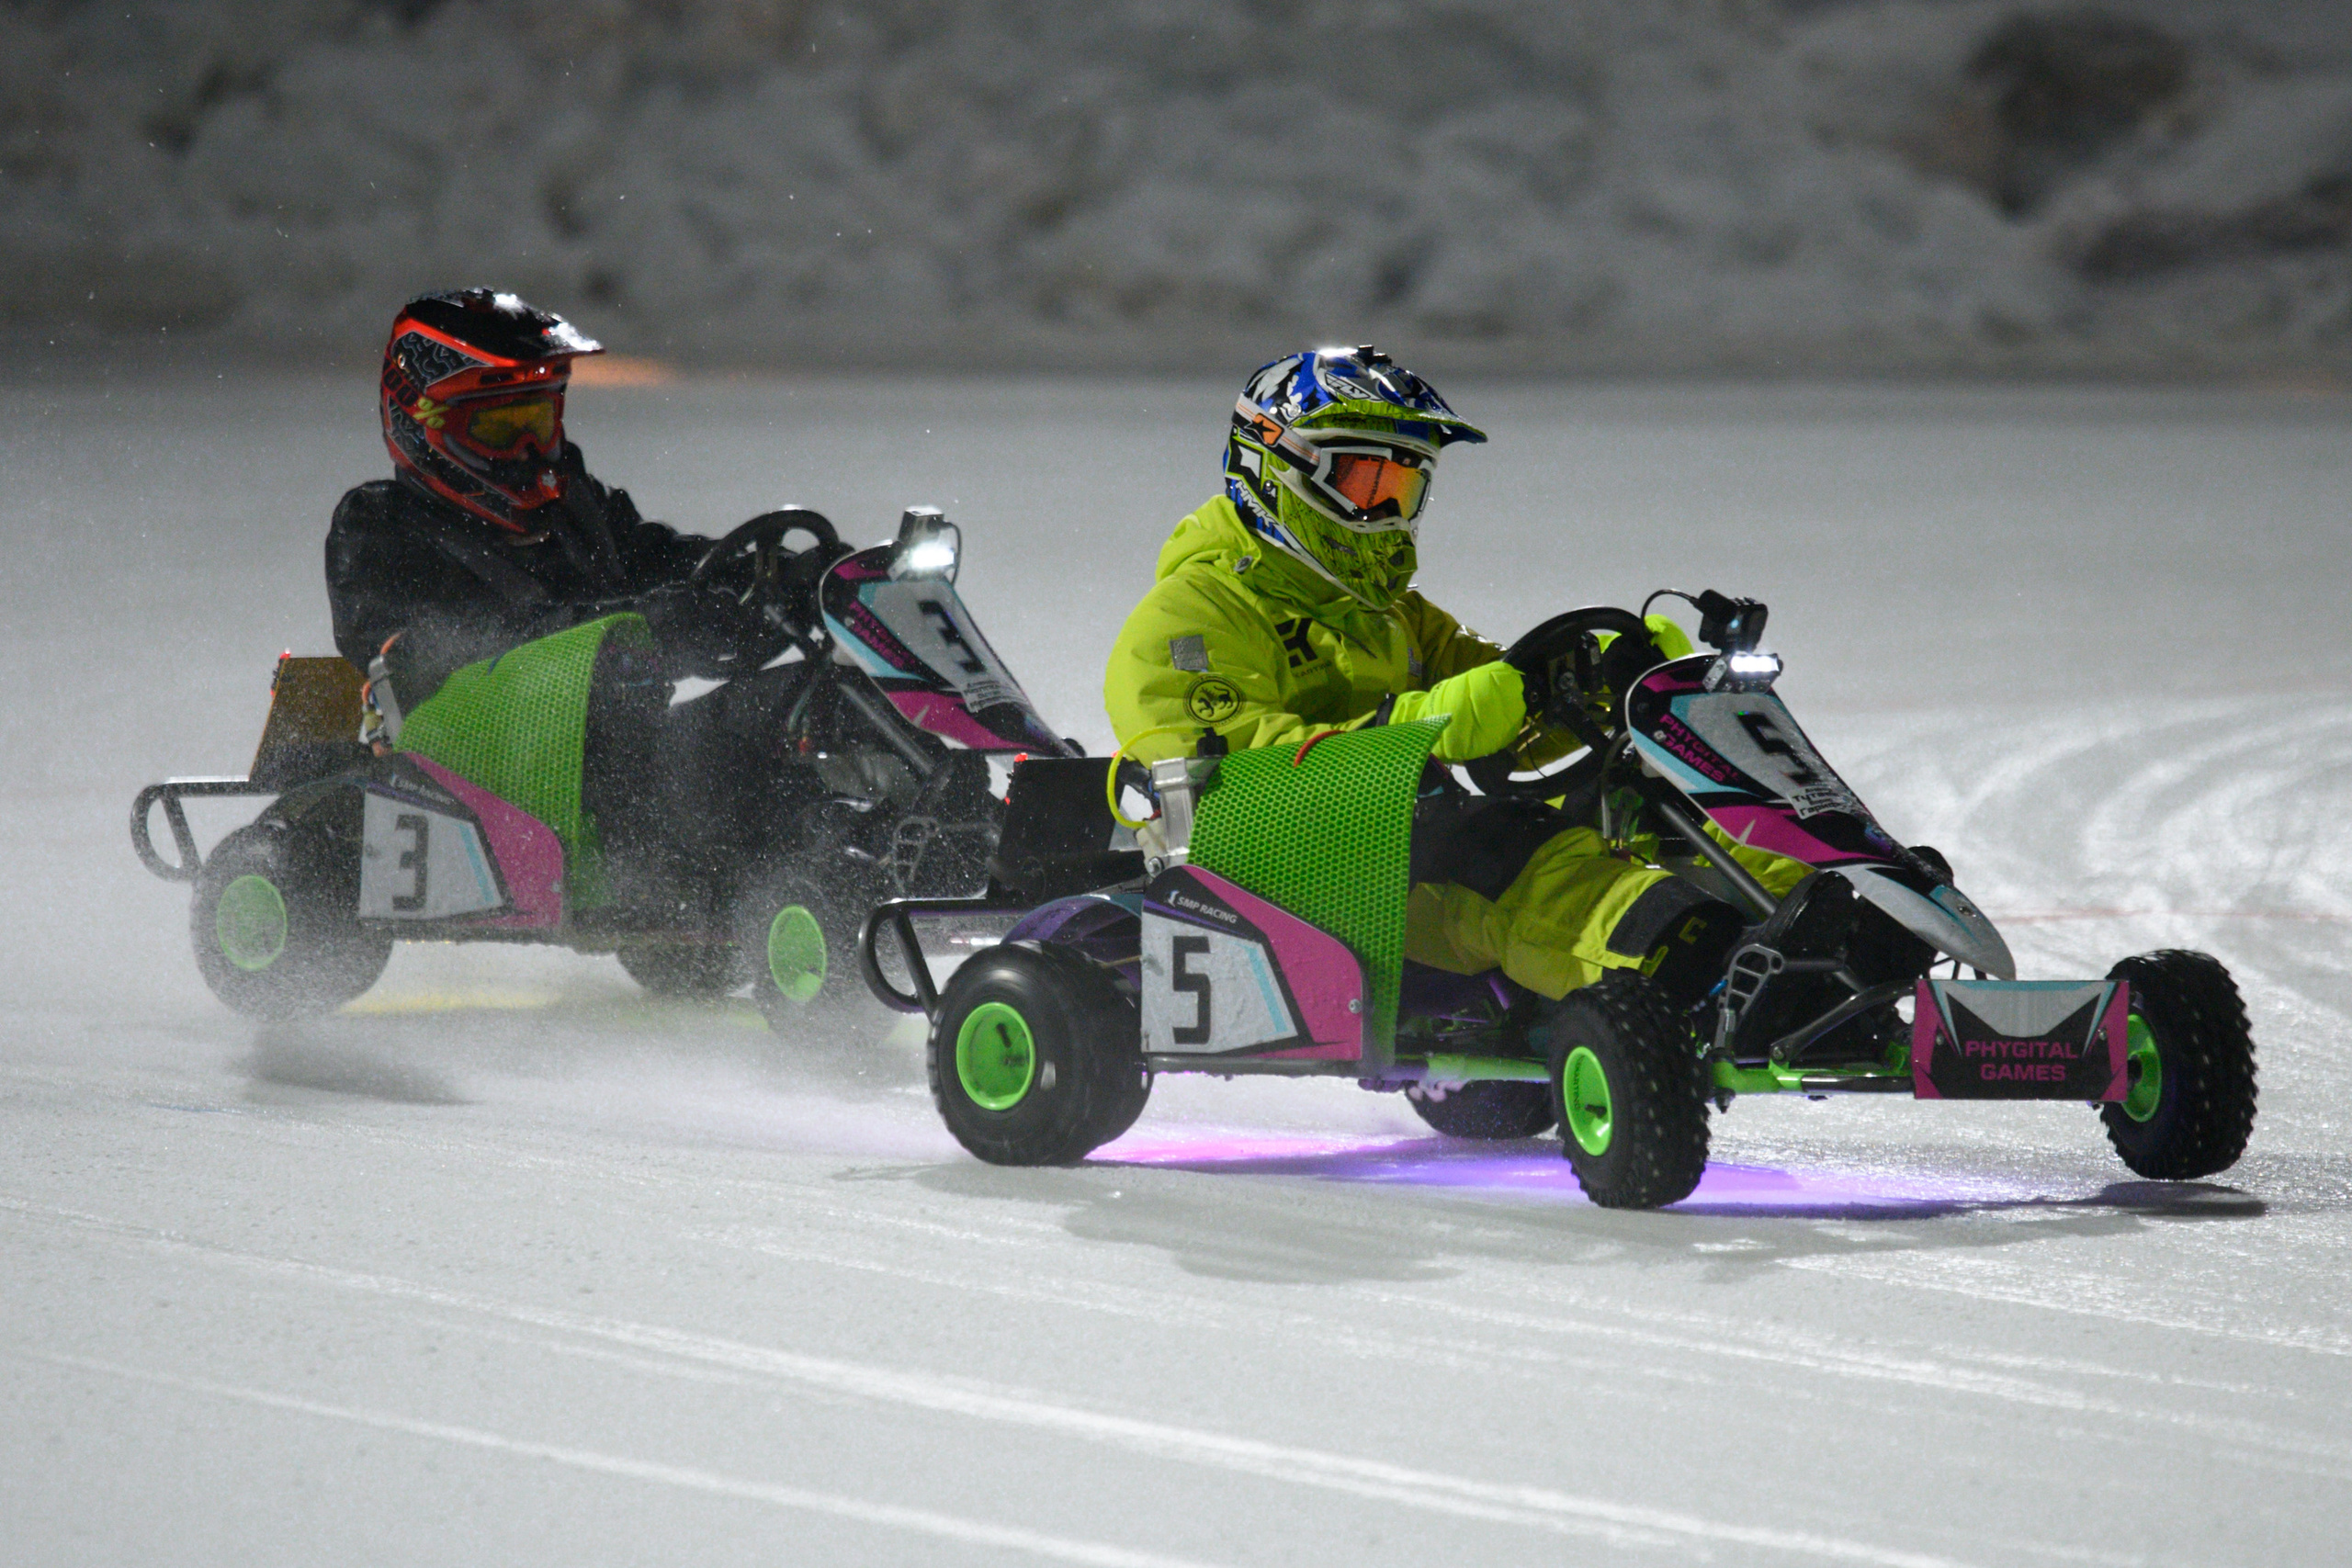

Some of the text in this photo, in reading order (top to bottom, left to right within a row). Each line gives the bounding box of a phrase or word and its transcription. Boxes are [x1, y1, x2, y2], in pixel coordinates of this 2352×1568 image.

[1325, 373, 1371, 400] FLY
[1235, 480, 1278, 528] HMK
[918, 600, 987, 673] 3
[1659, 714, 1739, 783] PHYGITAL
[1665, 733, 1726, 782] GAMES
[1735, 711, 1823, 785] 5
[392, 814, 429, 912] 3
[1177, 897, 1238, 924] SMP RACING
[1172, 936, 1211, 1044] 5
[1965, 1040, 2078, 1059] PHYGITAL
[1980, 1063, 2066, 1081] GAMES
